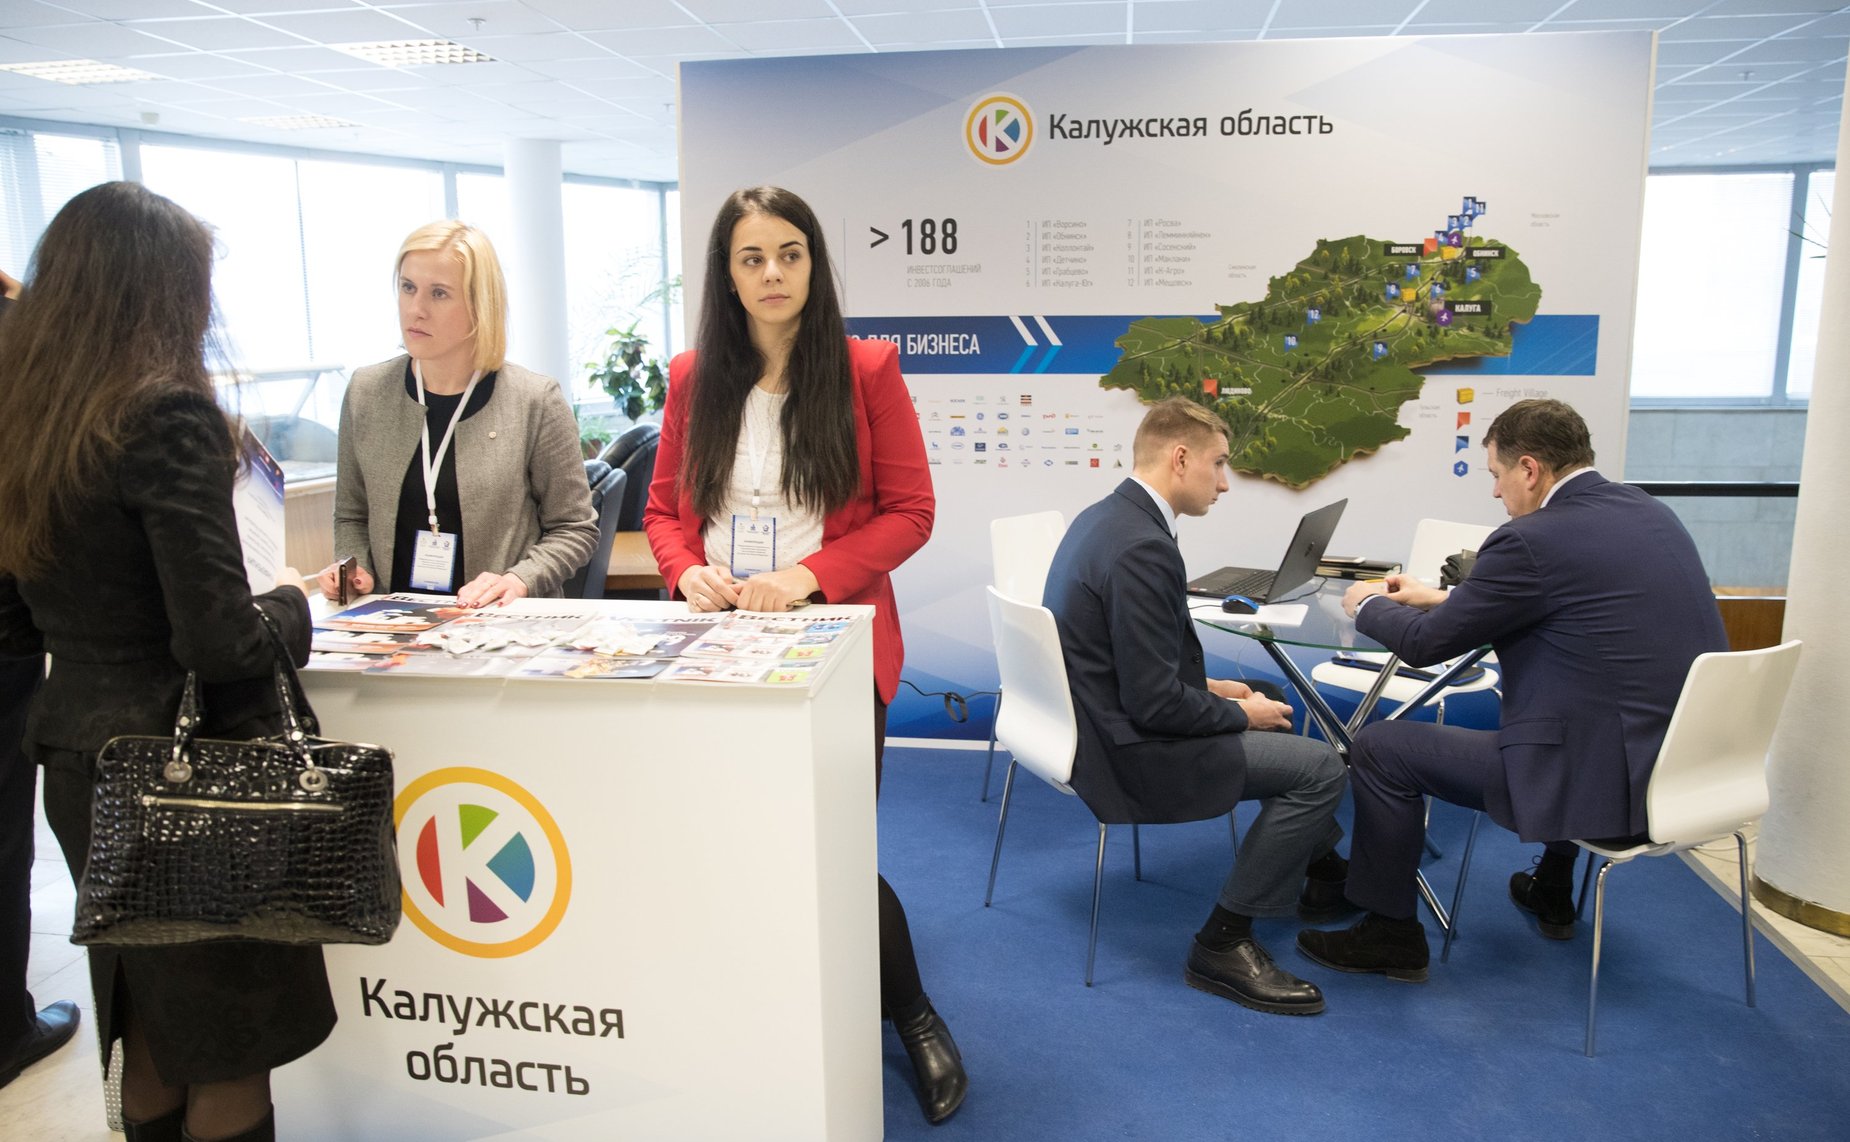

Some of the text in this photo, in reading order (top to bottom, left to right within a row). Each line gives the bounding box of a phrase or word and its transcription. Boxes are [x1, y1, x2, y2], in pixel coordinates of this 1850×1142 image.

[1049, 108, 1334, 146] Калужская область
[1467, 198, 1473, 208] 1
[1475, 204, 1484, 213] 11
[1042, 220, 1051, 228] ИП
[1144, 219, 1153, 227] ИП
[1451, 216, 1458, 227] 3
[1463, 216, 1470, 226] 2
[902, 218, 958, 255] 188
[1042, 232, 1051, 240] ИП
[1144, 230, 1153, 239] ИП
[1042, 243, 1051, 252] ИП
[1144, 242, 1153, 251] ИП
[1391, 246, 1417, 254] БОРОВСК
[1473, 249, 1499, 257] ОБНИНСК
[1042, 256, 1051, 264] ИП
[1144, 254, 1153, 263] ИП
[907, 263, 982, 275] ИНВЕСТСОГЛАШЕНИЙ
[1042, 267, 1051, 275] ИП
[1144, 266, 1153, 274] ИП
[1410, 265, 1416, 275] 7
[1470, 268, 1476, 277] 5
[933, 278, 952, 288] ГОДА
[1042, 279, 1051, 288] ИП
[1144, 278, 1153, 287] ИП
[1390, 284, 1396, 294] 8
[1435, 284, 1441, 294] 6
[1455, 304, 1482, 313] КАЛУГА
[1310, 309, 1320, 319] 12
[906, 334, 981, 355] БИЗНЕСА
[1287, 336, 1297, 346] 10
[1377, 343, 1383, 352] 9
[1496, 387, 1548, 400] Freight Village
[360, 976, 625, 1039] Калужская
[406, 1042, 590, 1096] область
